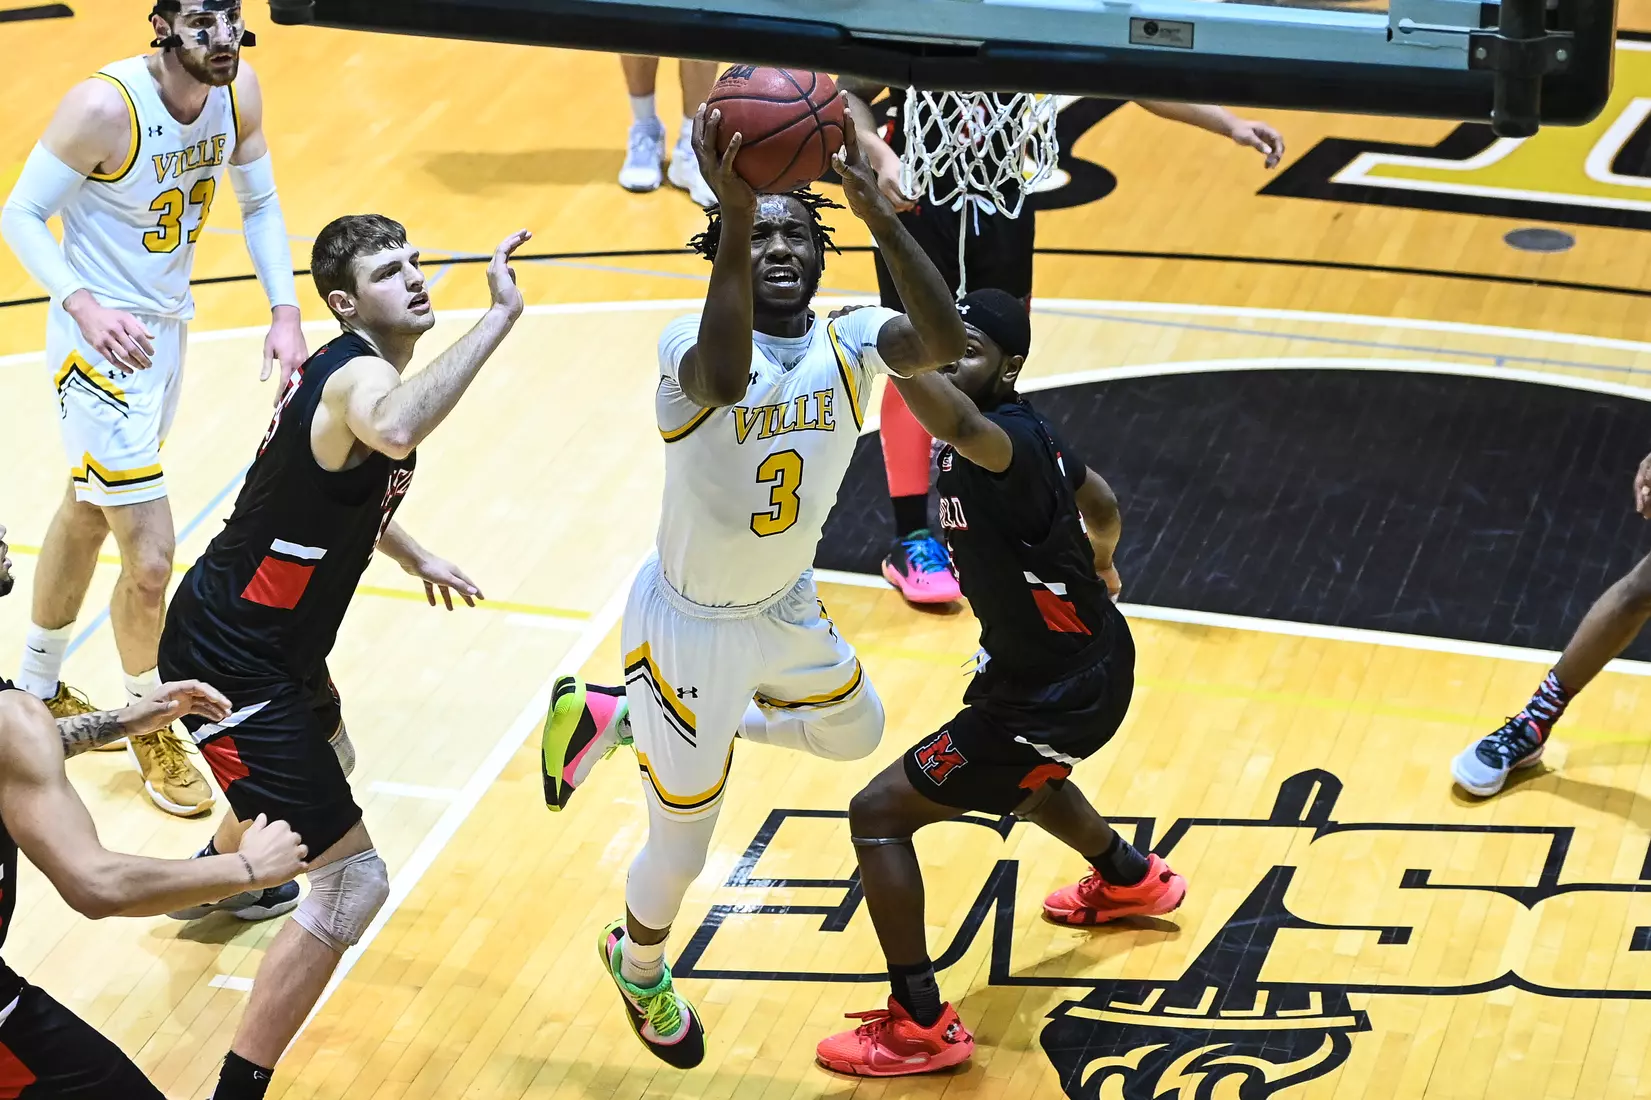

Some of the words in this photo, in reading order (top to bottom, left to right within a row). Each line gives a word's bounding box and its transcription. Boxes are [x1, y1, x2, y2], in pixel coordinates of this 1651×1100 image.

[152, 133, 227, 183] VILLE
[732, 388, 835, 444] VILLE
[750, 449, 804, 538] 3
[914, 730, 968, 786] M
